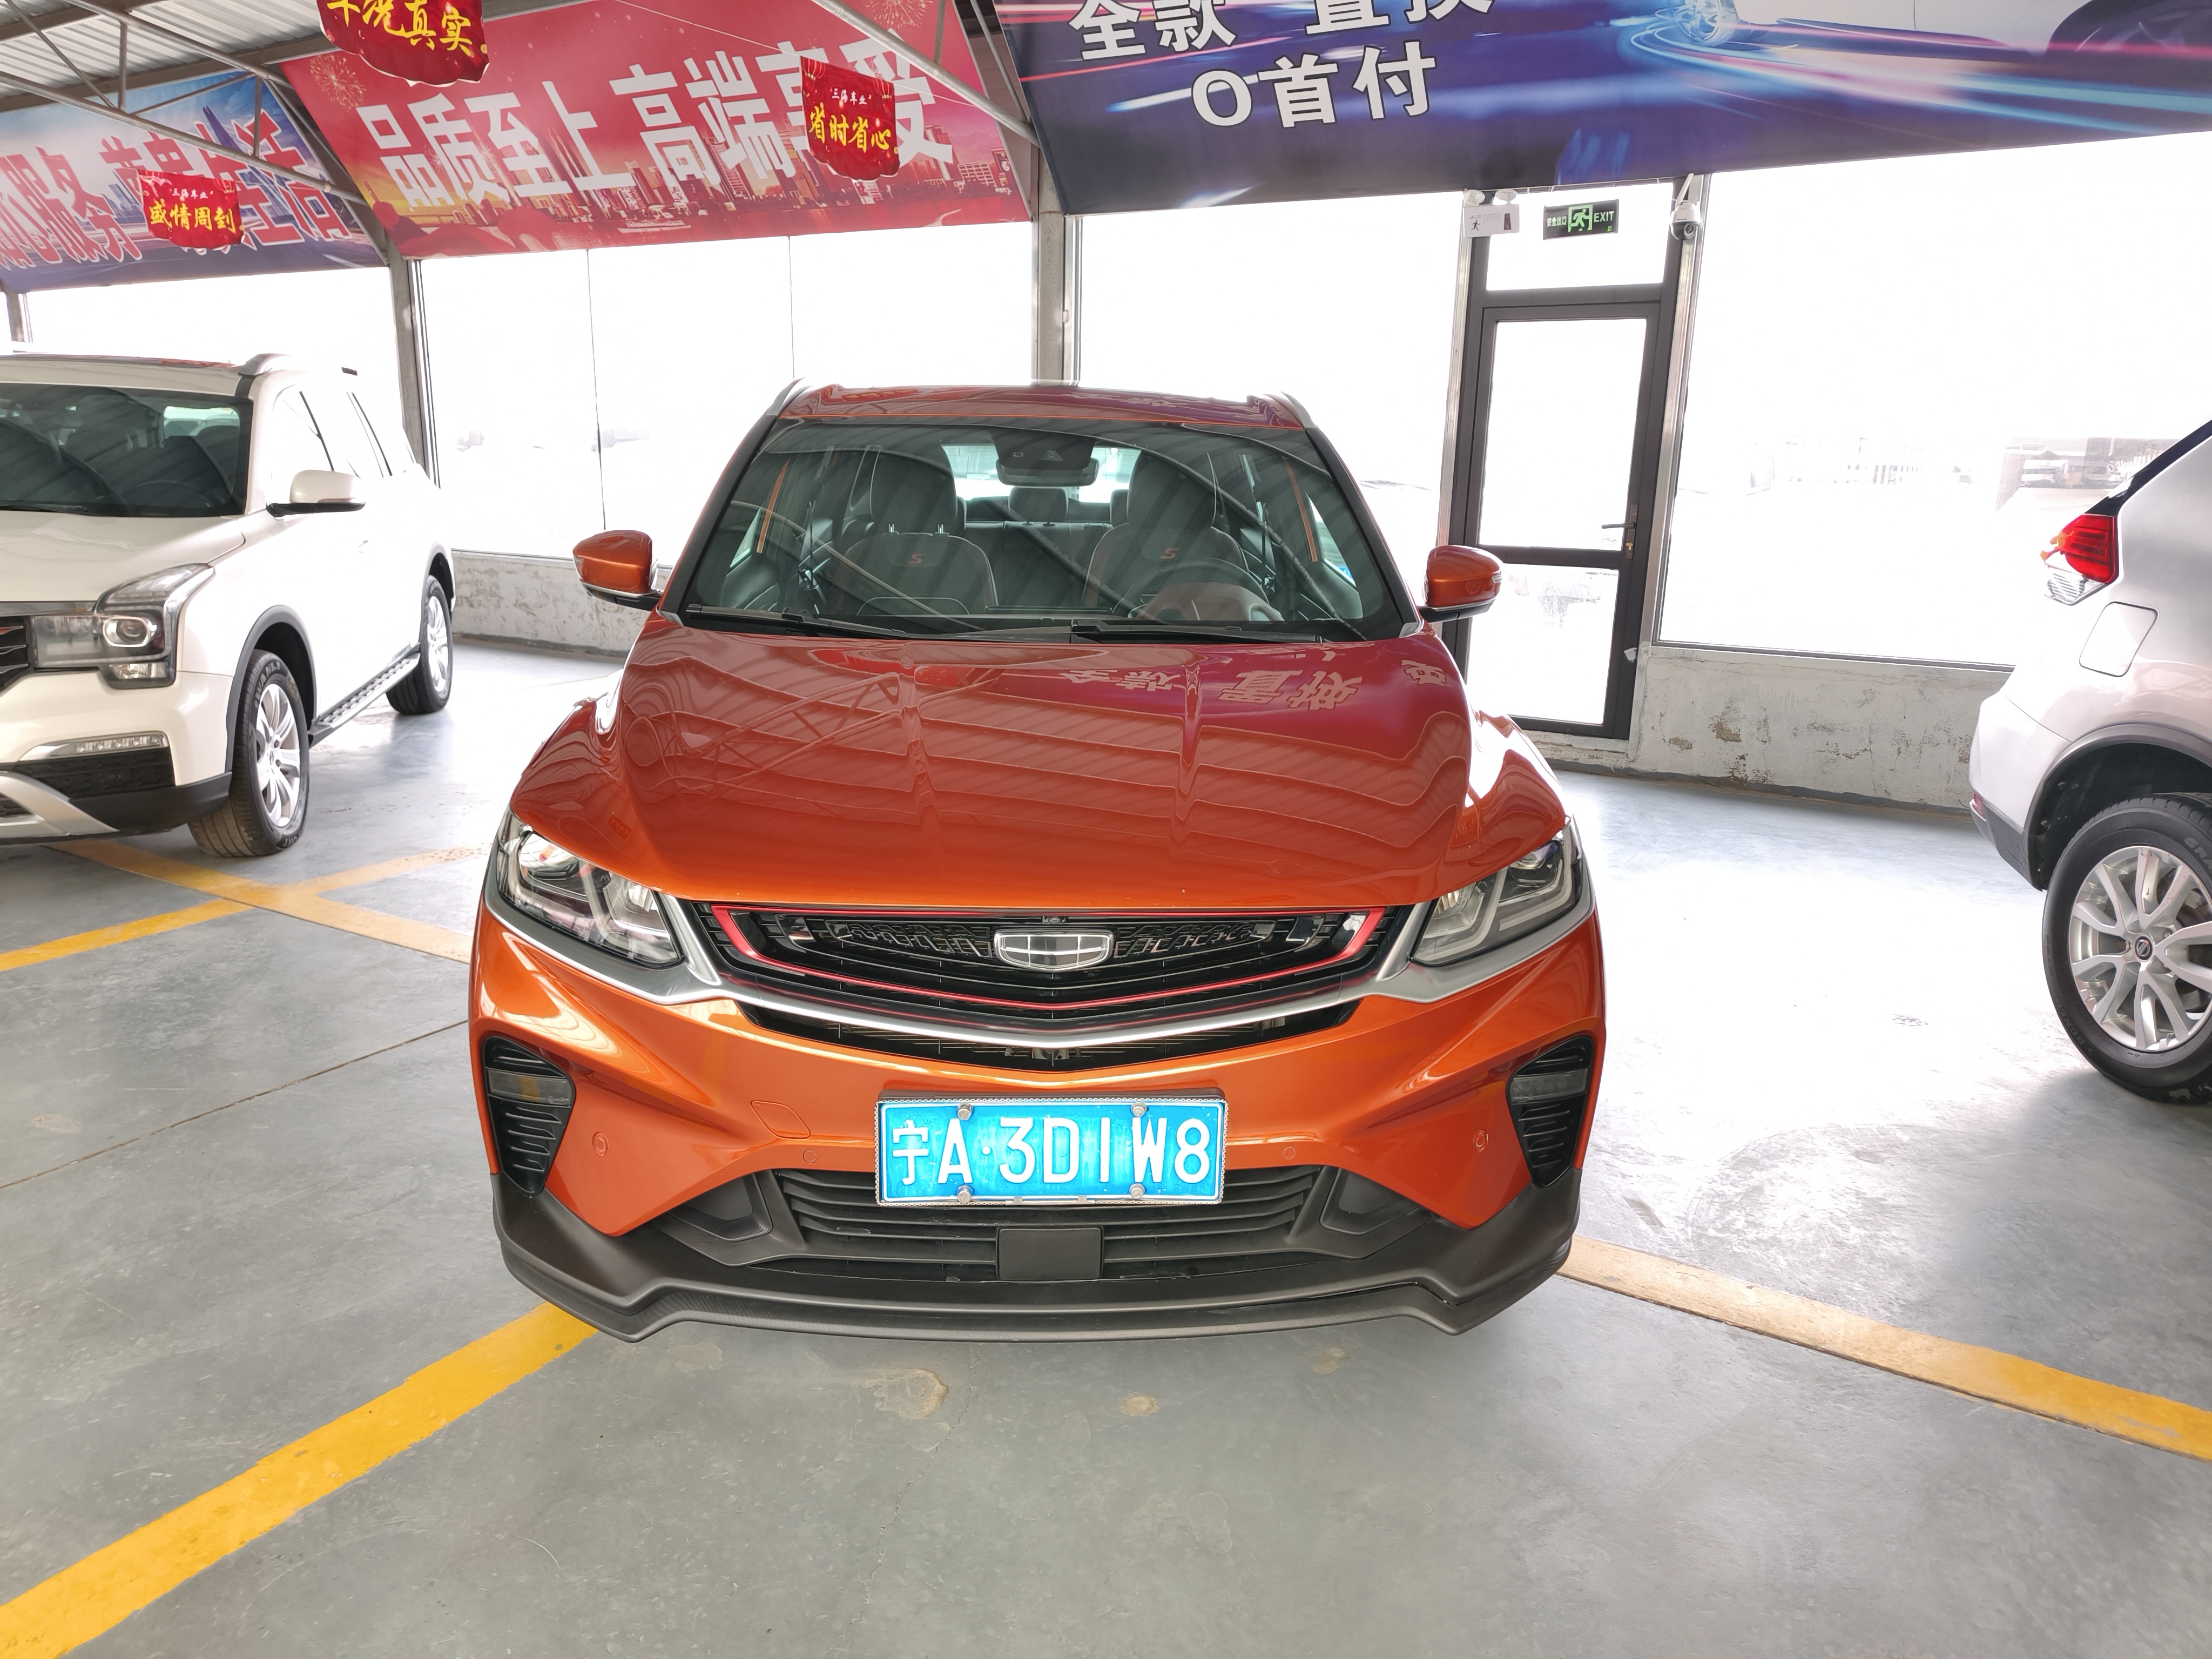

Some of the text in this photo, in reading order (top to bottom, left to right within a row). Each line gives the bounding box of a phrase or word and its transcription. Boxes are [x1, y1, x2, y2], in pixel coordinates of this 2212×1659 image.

[1068, 0, 1236, 60] 全款
[356, 80, 636, 212] 品质至上
[808, 105, 891, 153] 省时省心
[1546, 215, 1567, 227] 安全出口
[1594, 211, 1615, 222] EXIT
